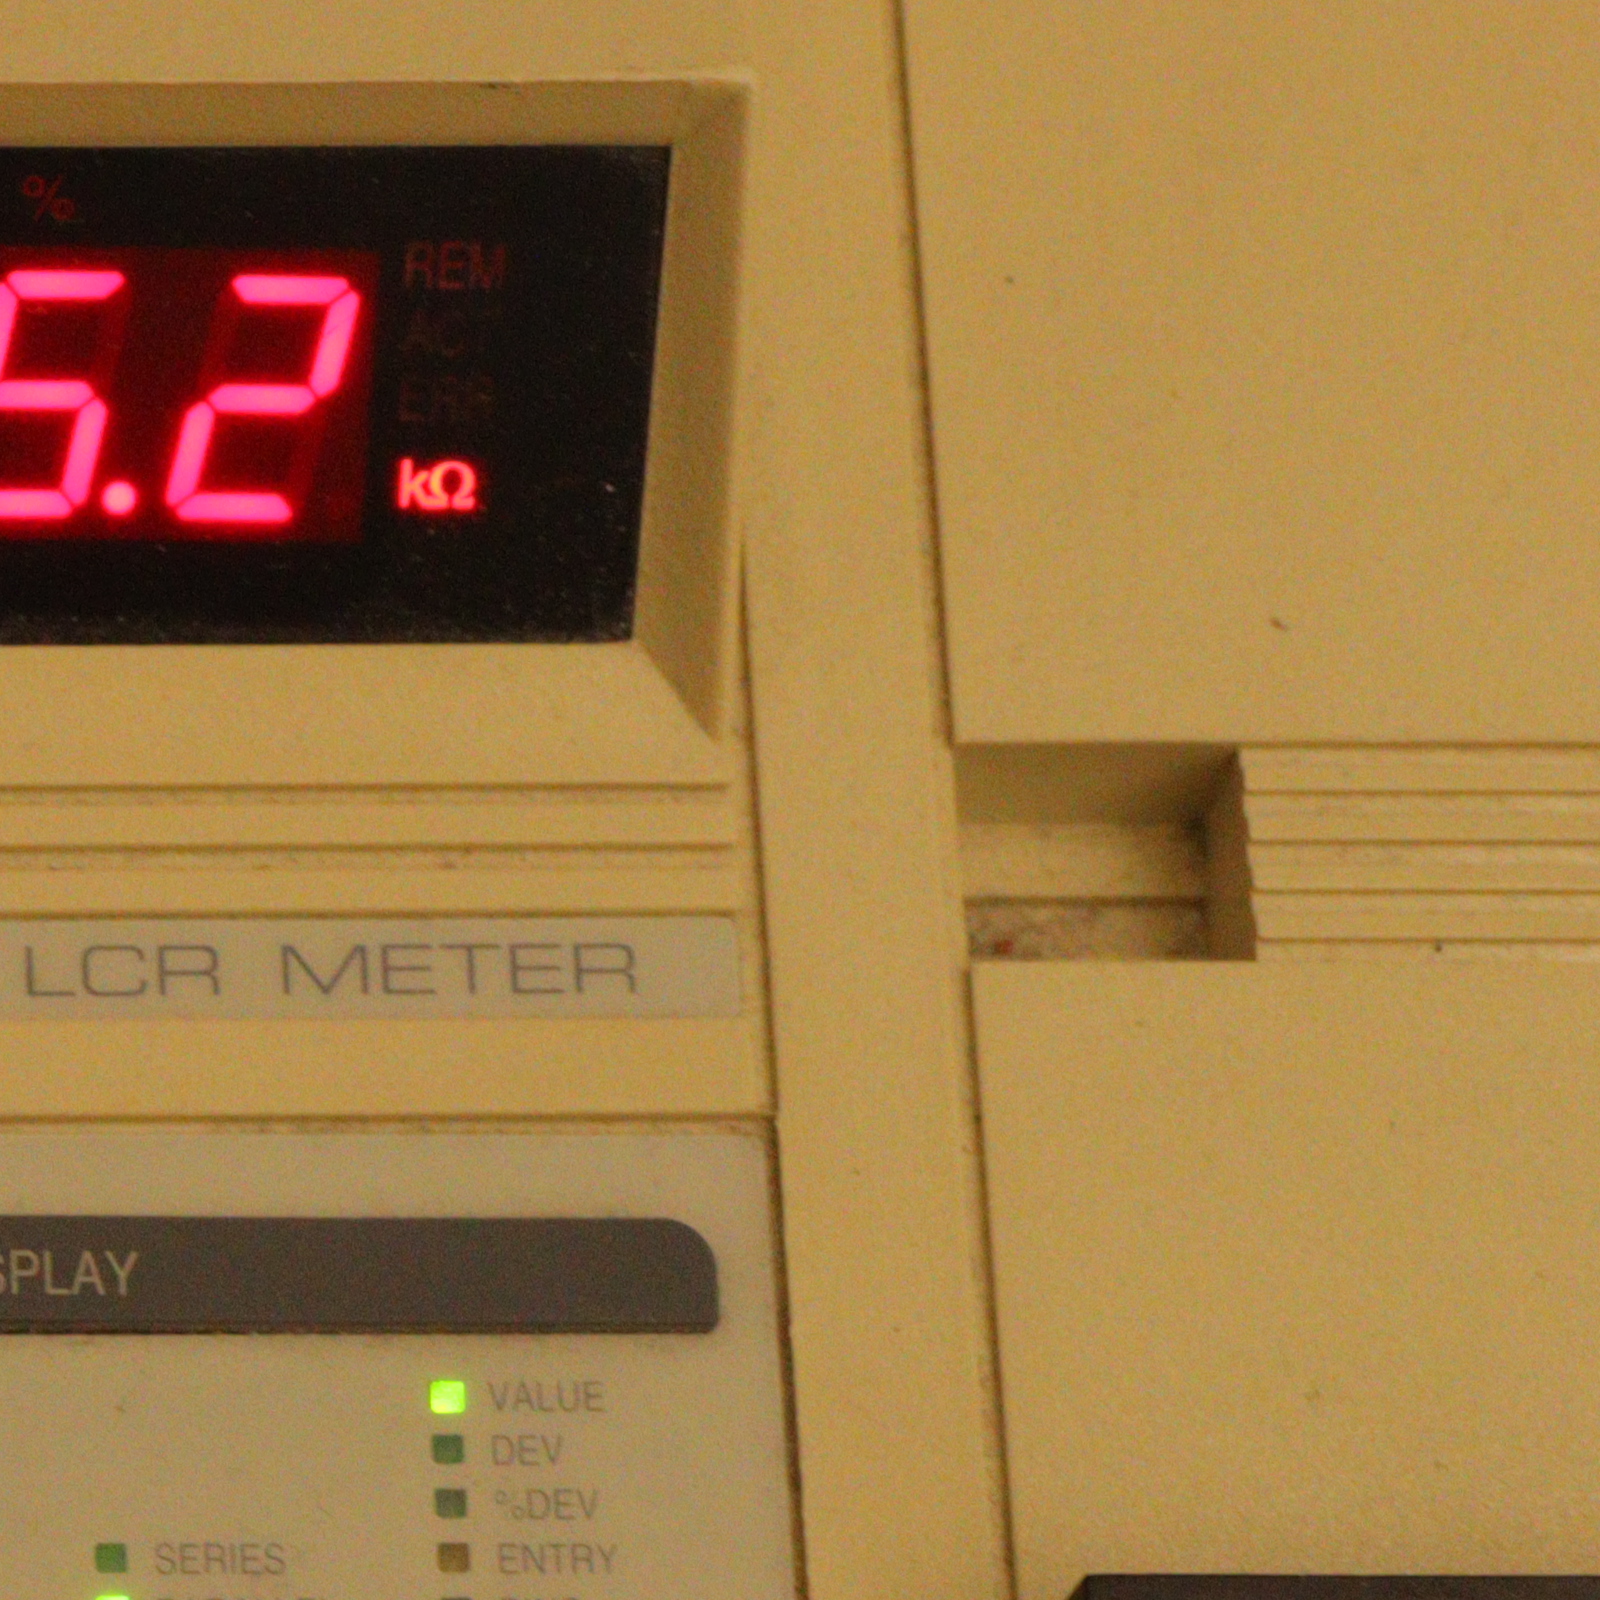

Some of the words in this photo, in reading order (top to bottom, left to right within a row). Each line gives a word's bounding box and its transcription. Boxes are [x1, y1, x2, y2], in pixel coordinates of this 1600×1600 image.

[399, 457, 477, 511] kΩ
[23, 944, 222, 999] LCR
[279, 942, 638, 997] METER
[487, 1380, 606, 1414] VALUE
[490, 1433, 564, 1467] DEV
[494, 1487, 600, 1522] %DEV
[153, 1540, 287, 1578] SERIES
[496, 1541, 618, 1577] ENTRY
